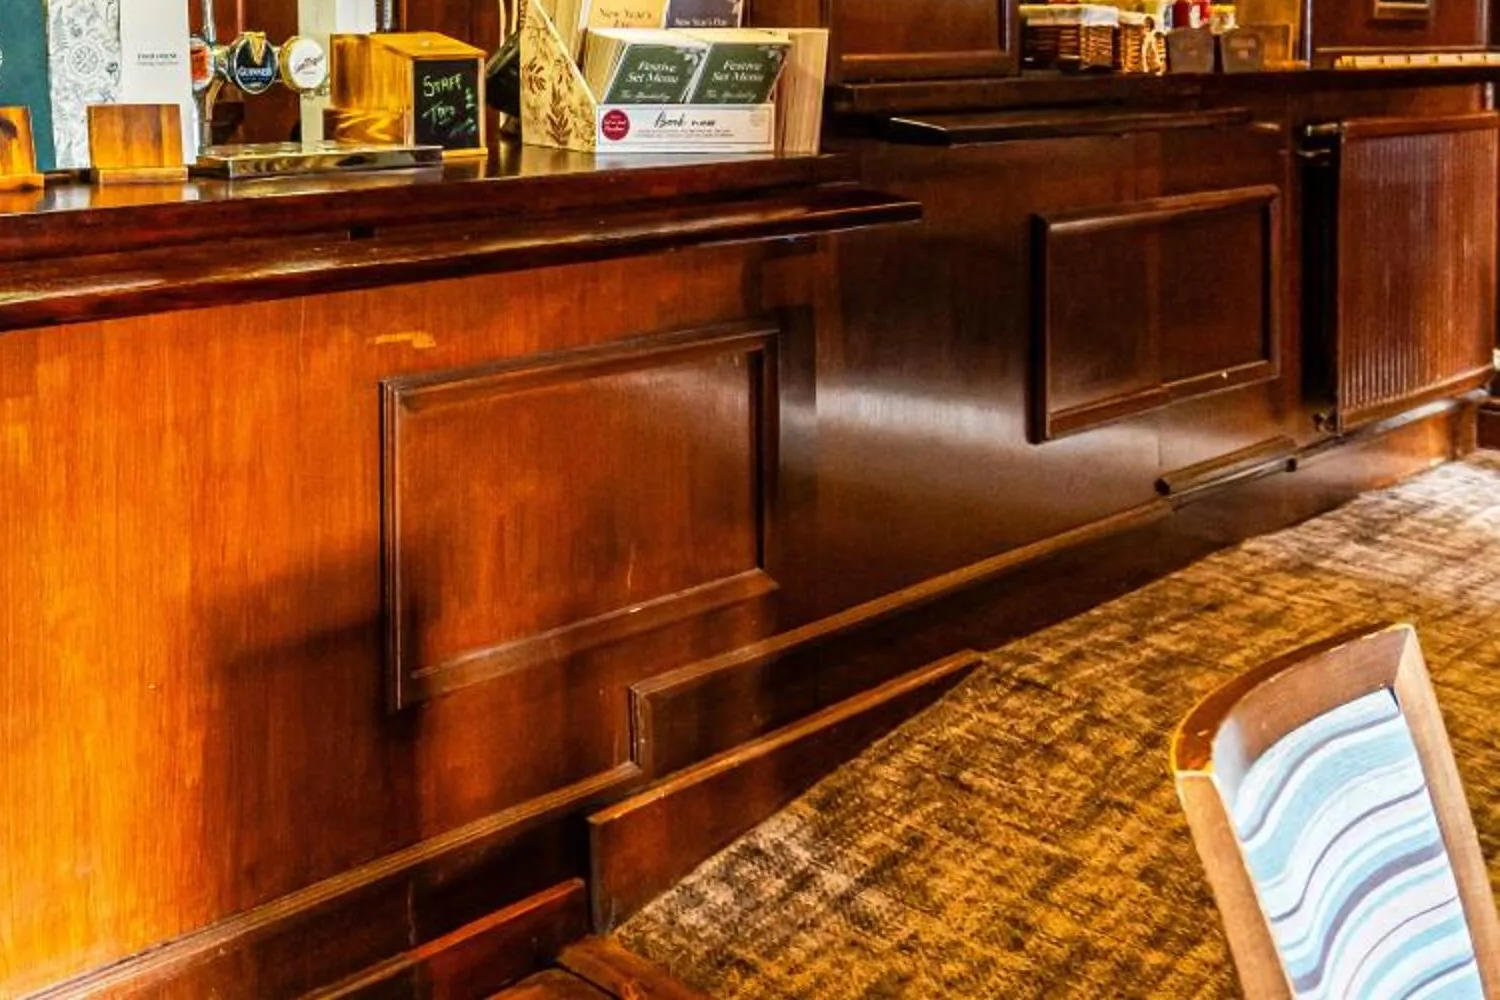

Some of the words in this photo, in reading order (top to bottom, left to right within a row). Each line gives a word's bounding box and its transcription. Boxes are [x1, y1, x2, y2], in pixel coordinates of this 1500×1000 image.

[600, 7, 619, 19] New
[675, 17, 690, 26] New
[238, 65, 273, 77] GUINNESS
[637, 60, 677, 73] Festive
[723, 60, 763, 71] Festive
[626, 73, 646, 83] Set
[649, 73, 680, 84] Menu
[712, 72, 730, 82] Set
[733, 72, 764, 82] Menu
[423, 72, 462, 98] STAFF
